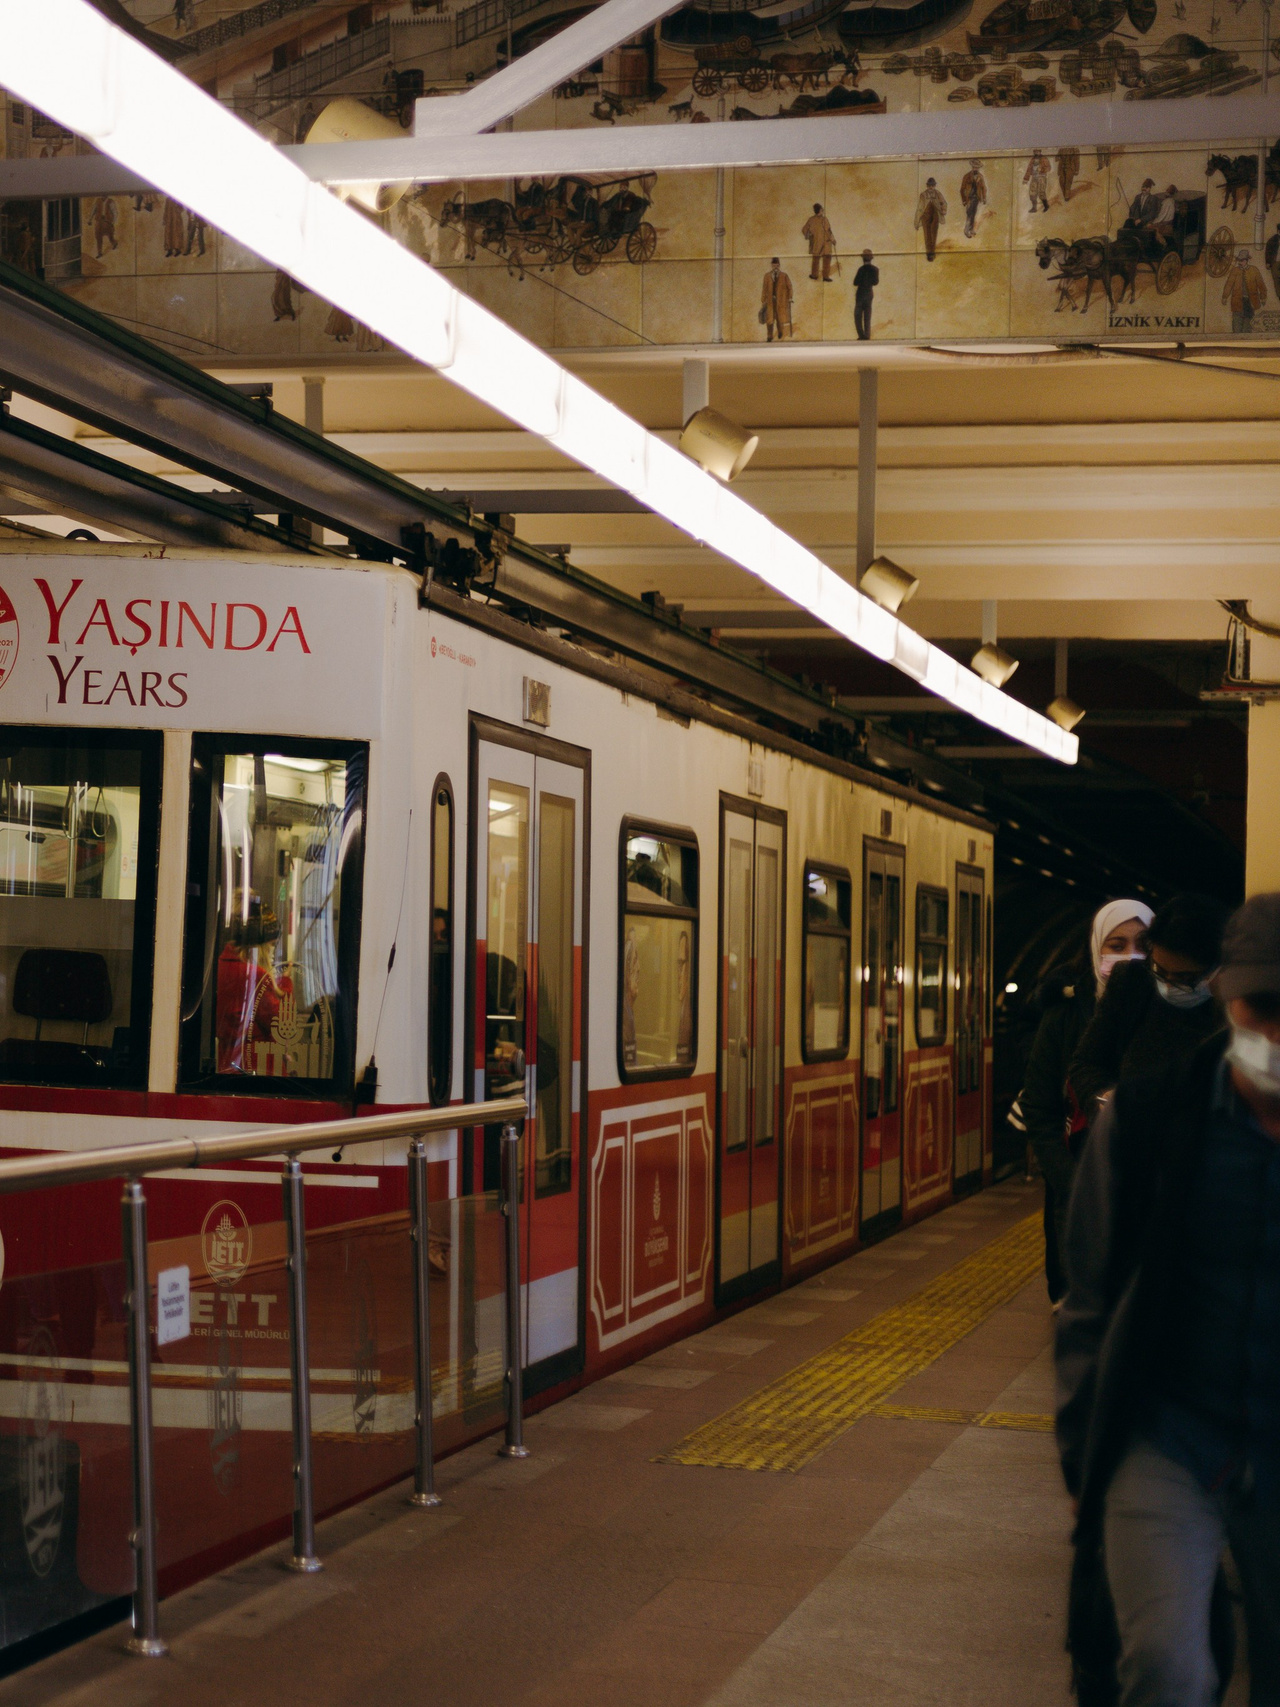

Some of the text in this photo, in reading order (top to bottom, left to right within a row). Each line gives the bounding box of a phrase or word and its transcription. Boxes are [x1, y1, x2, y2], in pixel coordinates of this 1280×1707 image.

[1108, 313, 1201, 327] İZNİK VAKFI
[33, 578, 312, 656] YAŞINDA
[46, 655, 188, 708] YEARS
[190, 1291, 278, 1326] ETT
